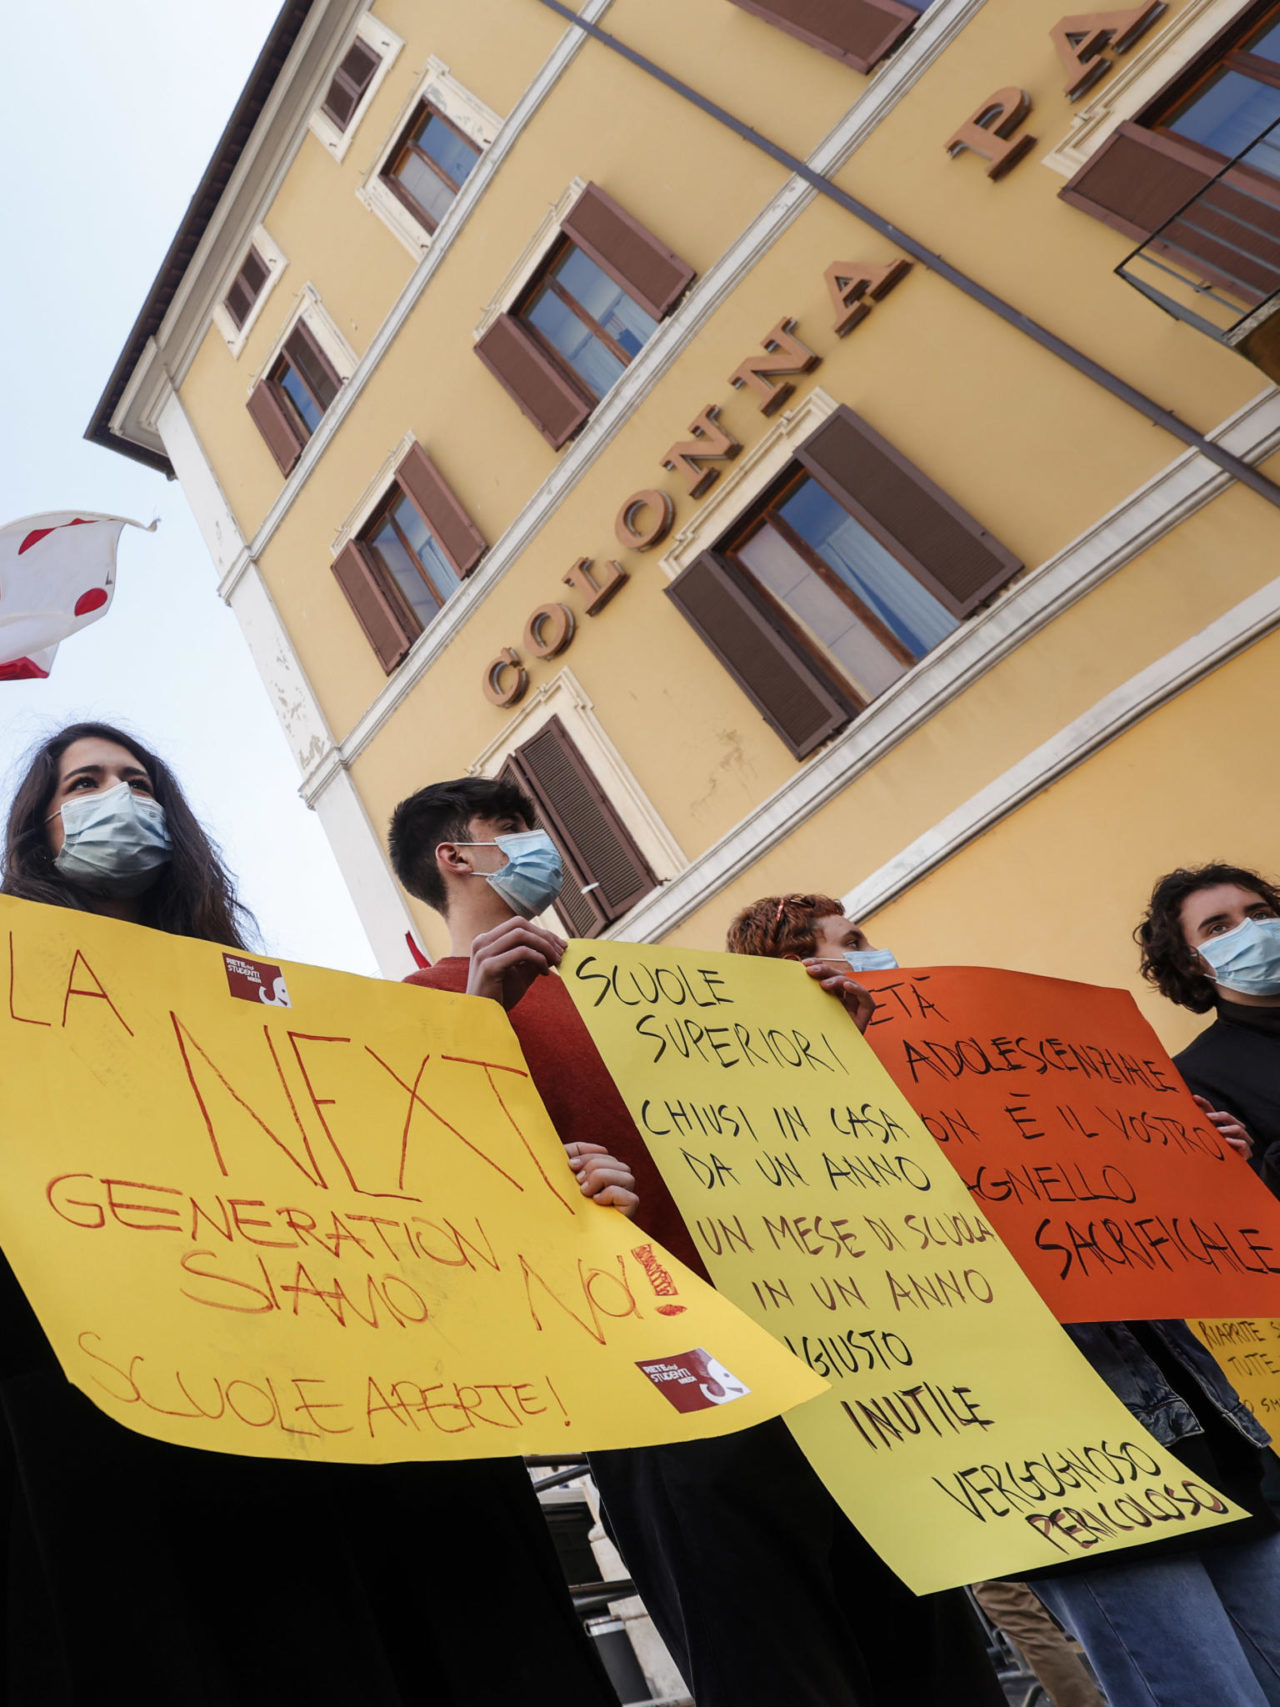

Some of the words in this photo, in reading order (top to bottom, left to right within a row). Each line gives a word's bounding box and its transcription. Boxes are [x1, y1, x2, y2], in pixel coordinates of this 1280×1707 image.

[482, 258, 913, 709] COLONNA
[7, 929, 135, 1037] LA
[575, 956, 735, 1008] SCUOLE
[635, 1014, 850, 1076] SUPERIORI
[902, 1036, 1181, 1094] ADOLESCENZIALE
[169, 1010, 576, 1215] NEXT
[641, 1099, 760, 1143] CHIUSI
[772, 1105, 811, 1142] IN
[830, 1103, 910, 1144] CASA
[1056, 1104, 1100, 1139] IL
[1095, 1106, 1225, 1163] VOSTRO
[679, 1147, 742, 1190] DA
[754, 1151, 811, 1188] UN
[821, 1152, 932, 1192] ANNO
[45, 1172, 501, 1272] GENERATION
[696, 1214, 756, 1256] UN
[760, 1215, 867, 1259] MESE
[862, 1214, 907, 1252] DI
[904, 1212, 998, 1251] SCUOLA
[1034, 1216, 1280, 1281] SACRIFICALE
[179, 1248, 430, 1328] SIAMO
[751, 1278, 795, 1312] IN
[809, 1275, 871, 1312] UN
[884, 1268, 995, 1312] ANNO
[77, 1331, 354, 1437] SCUOLE
[365, 1374, 573, 1438] APERTE!
[839, 1380, 997, 1452] INUTILE
[930, 1438, 1163, 1524] VERGOGNOSO
[1024, 1480, 1230, 1555] PERICOLOSO
